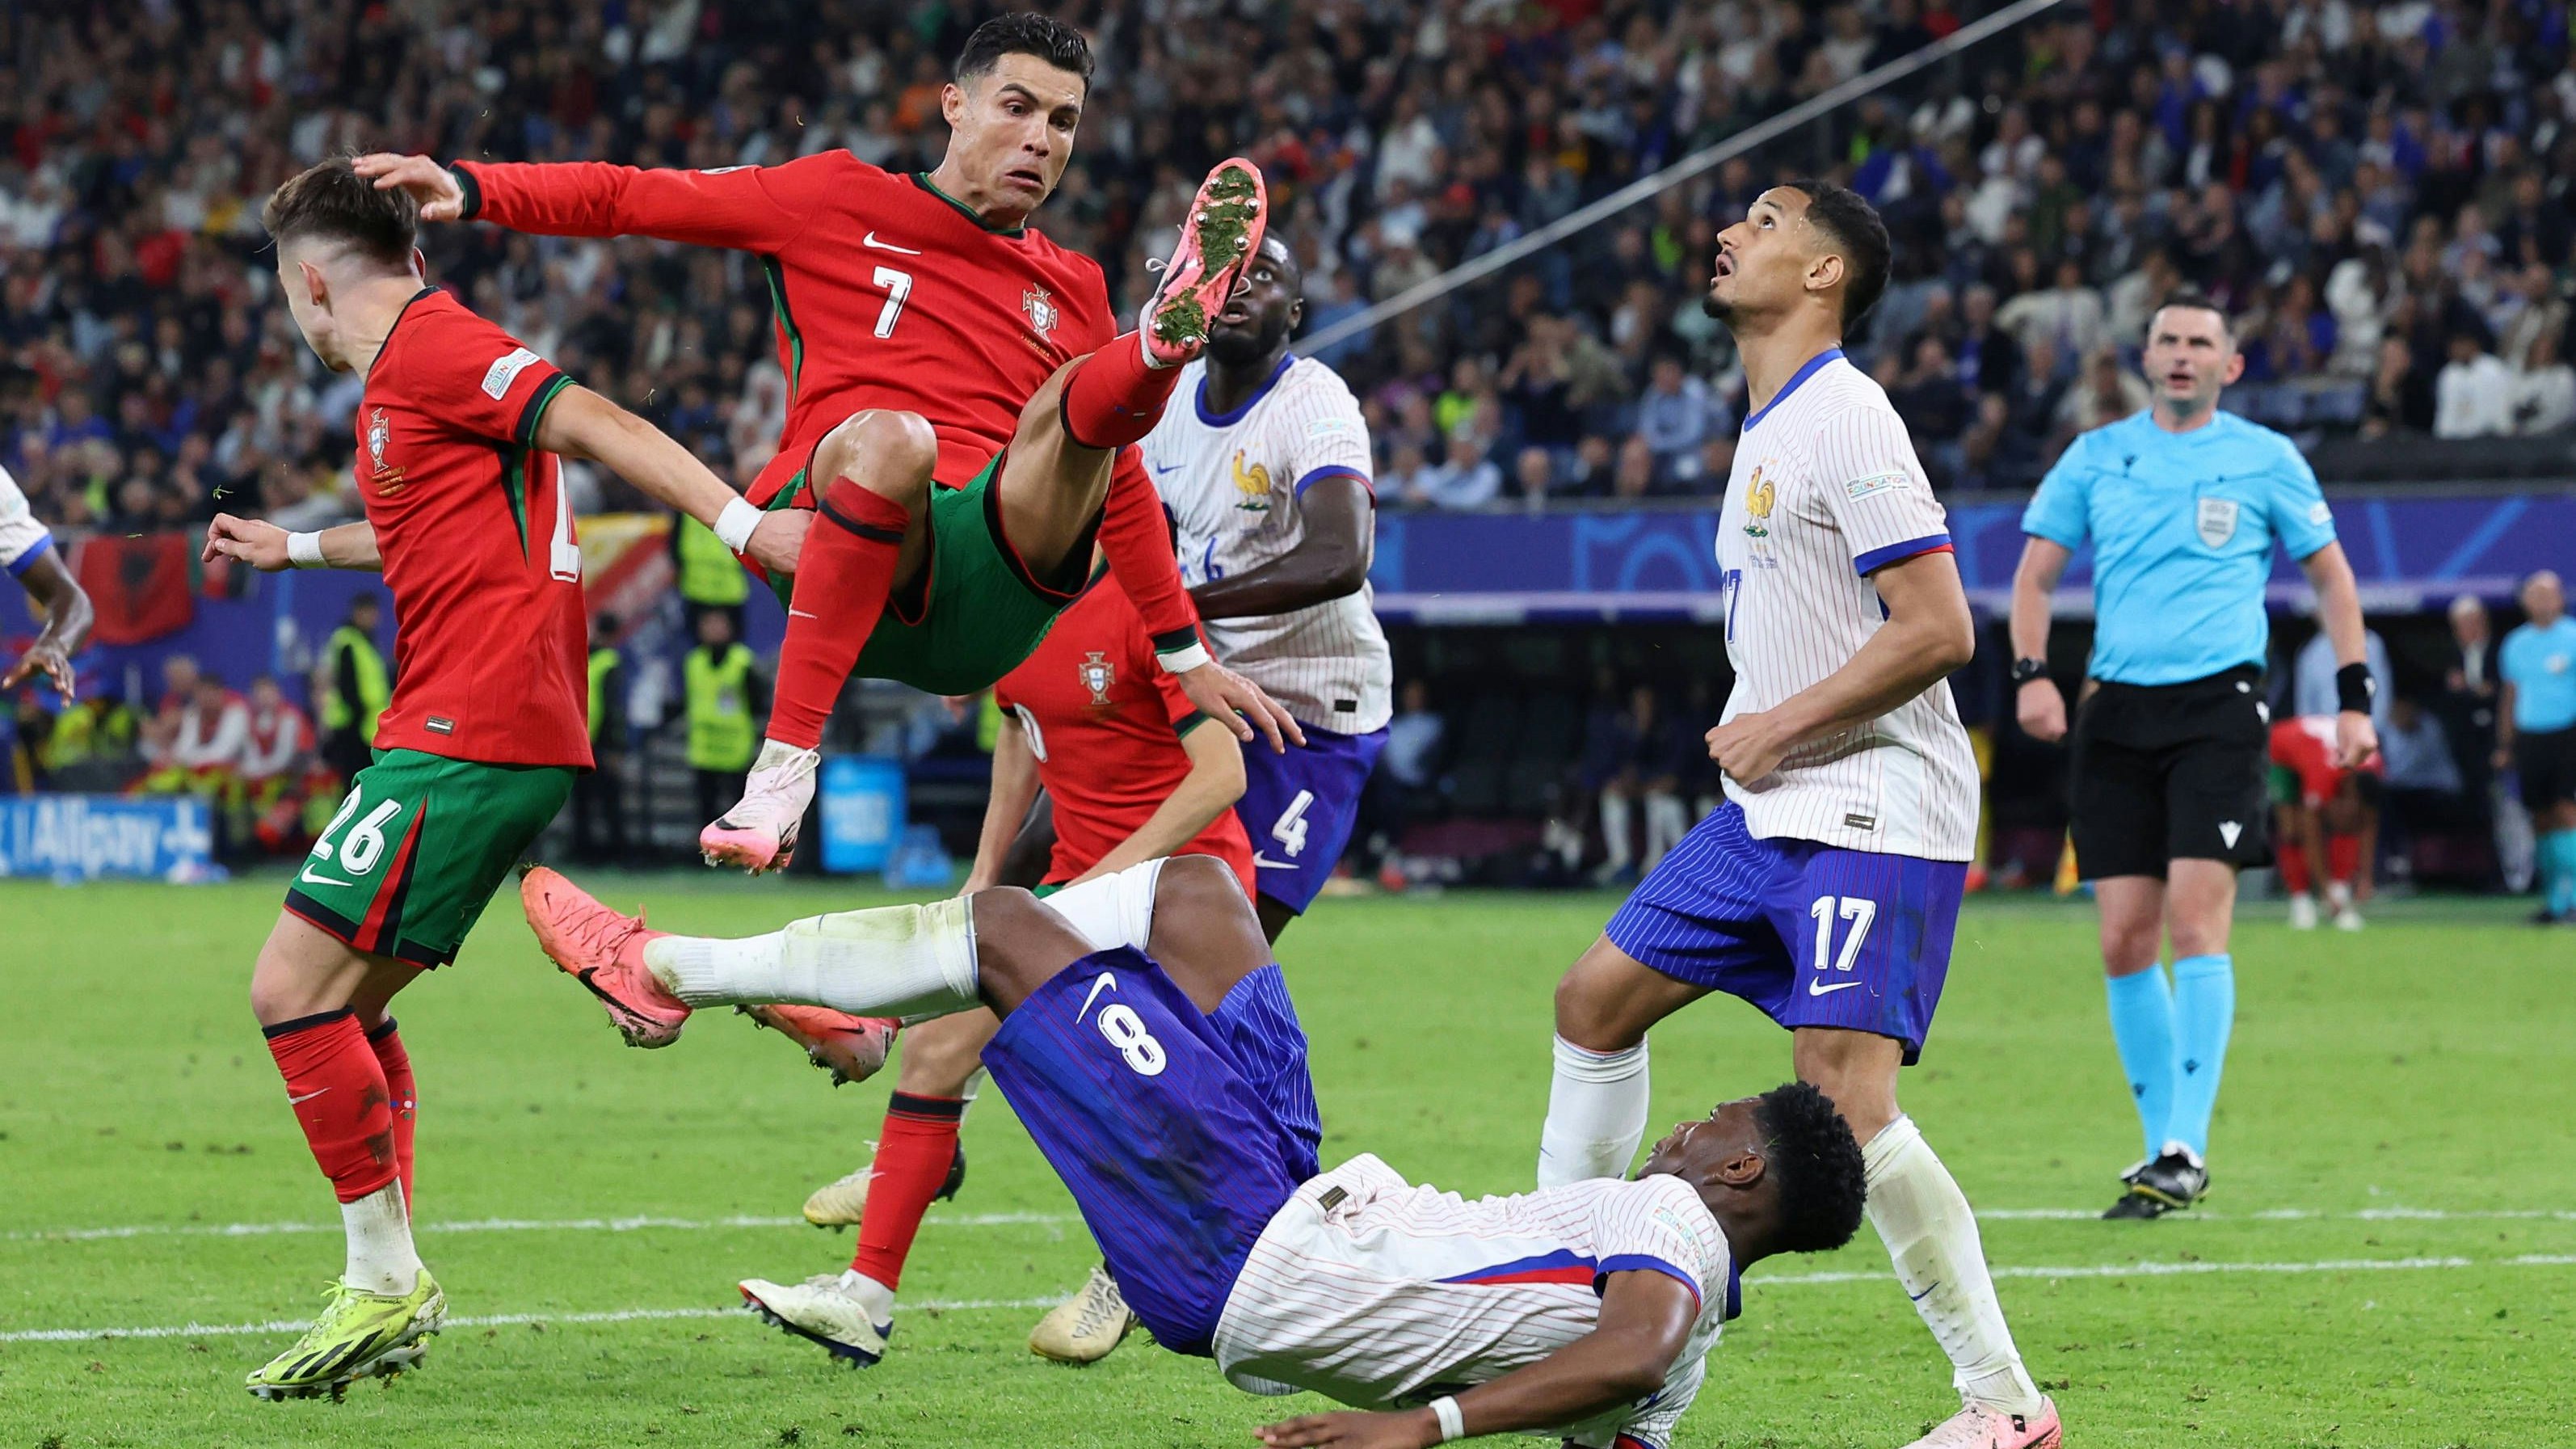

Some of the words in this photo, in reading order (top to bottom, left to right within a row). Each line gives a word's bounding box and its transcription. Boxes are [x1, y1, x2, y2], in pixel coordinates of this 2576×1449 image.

[873, 265, 912, 339] 7
[312, 783, 402, 875] 26
[1271, 789, 1314, 857] 4
[1811, 895, 1876, 971] 17
[1097, 1004, 1167, 1076] 8
